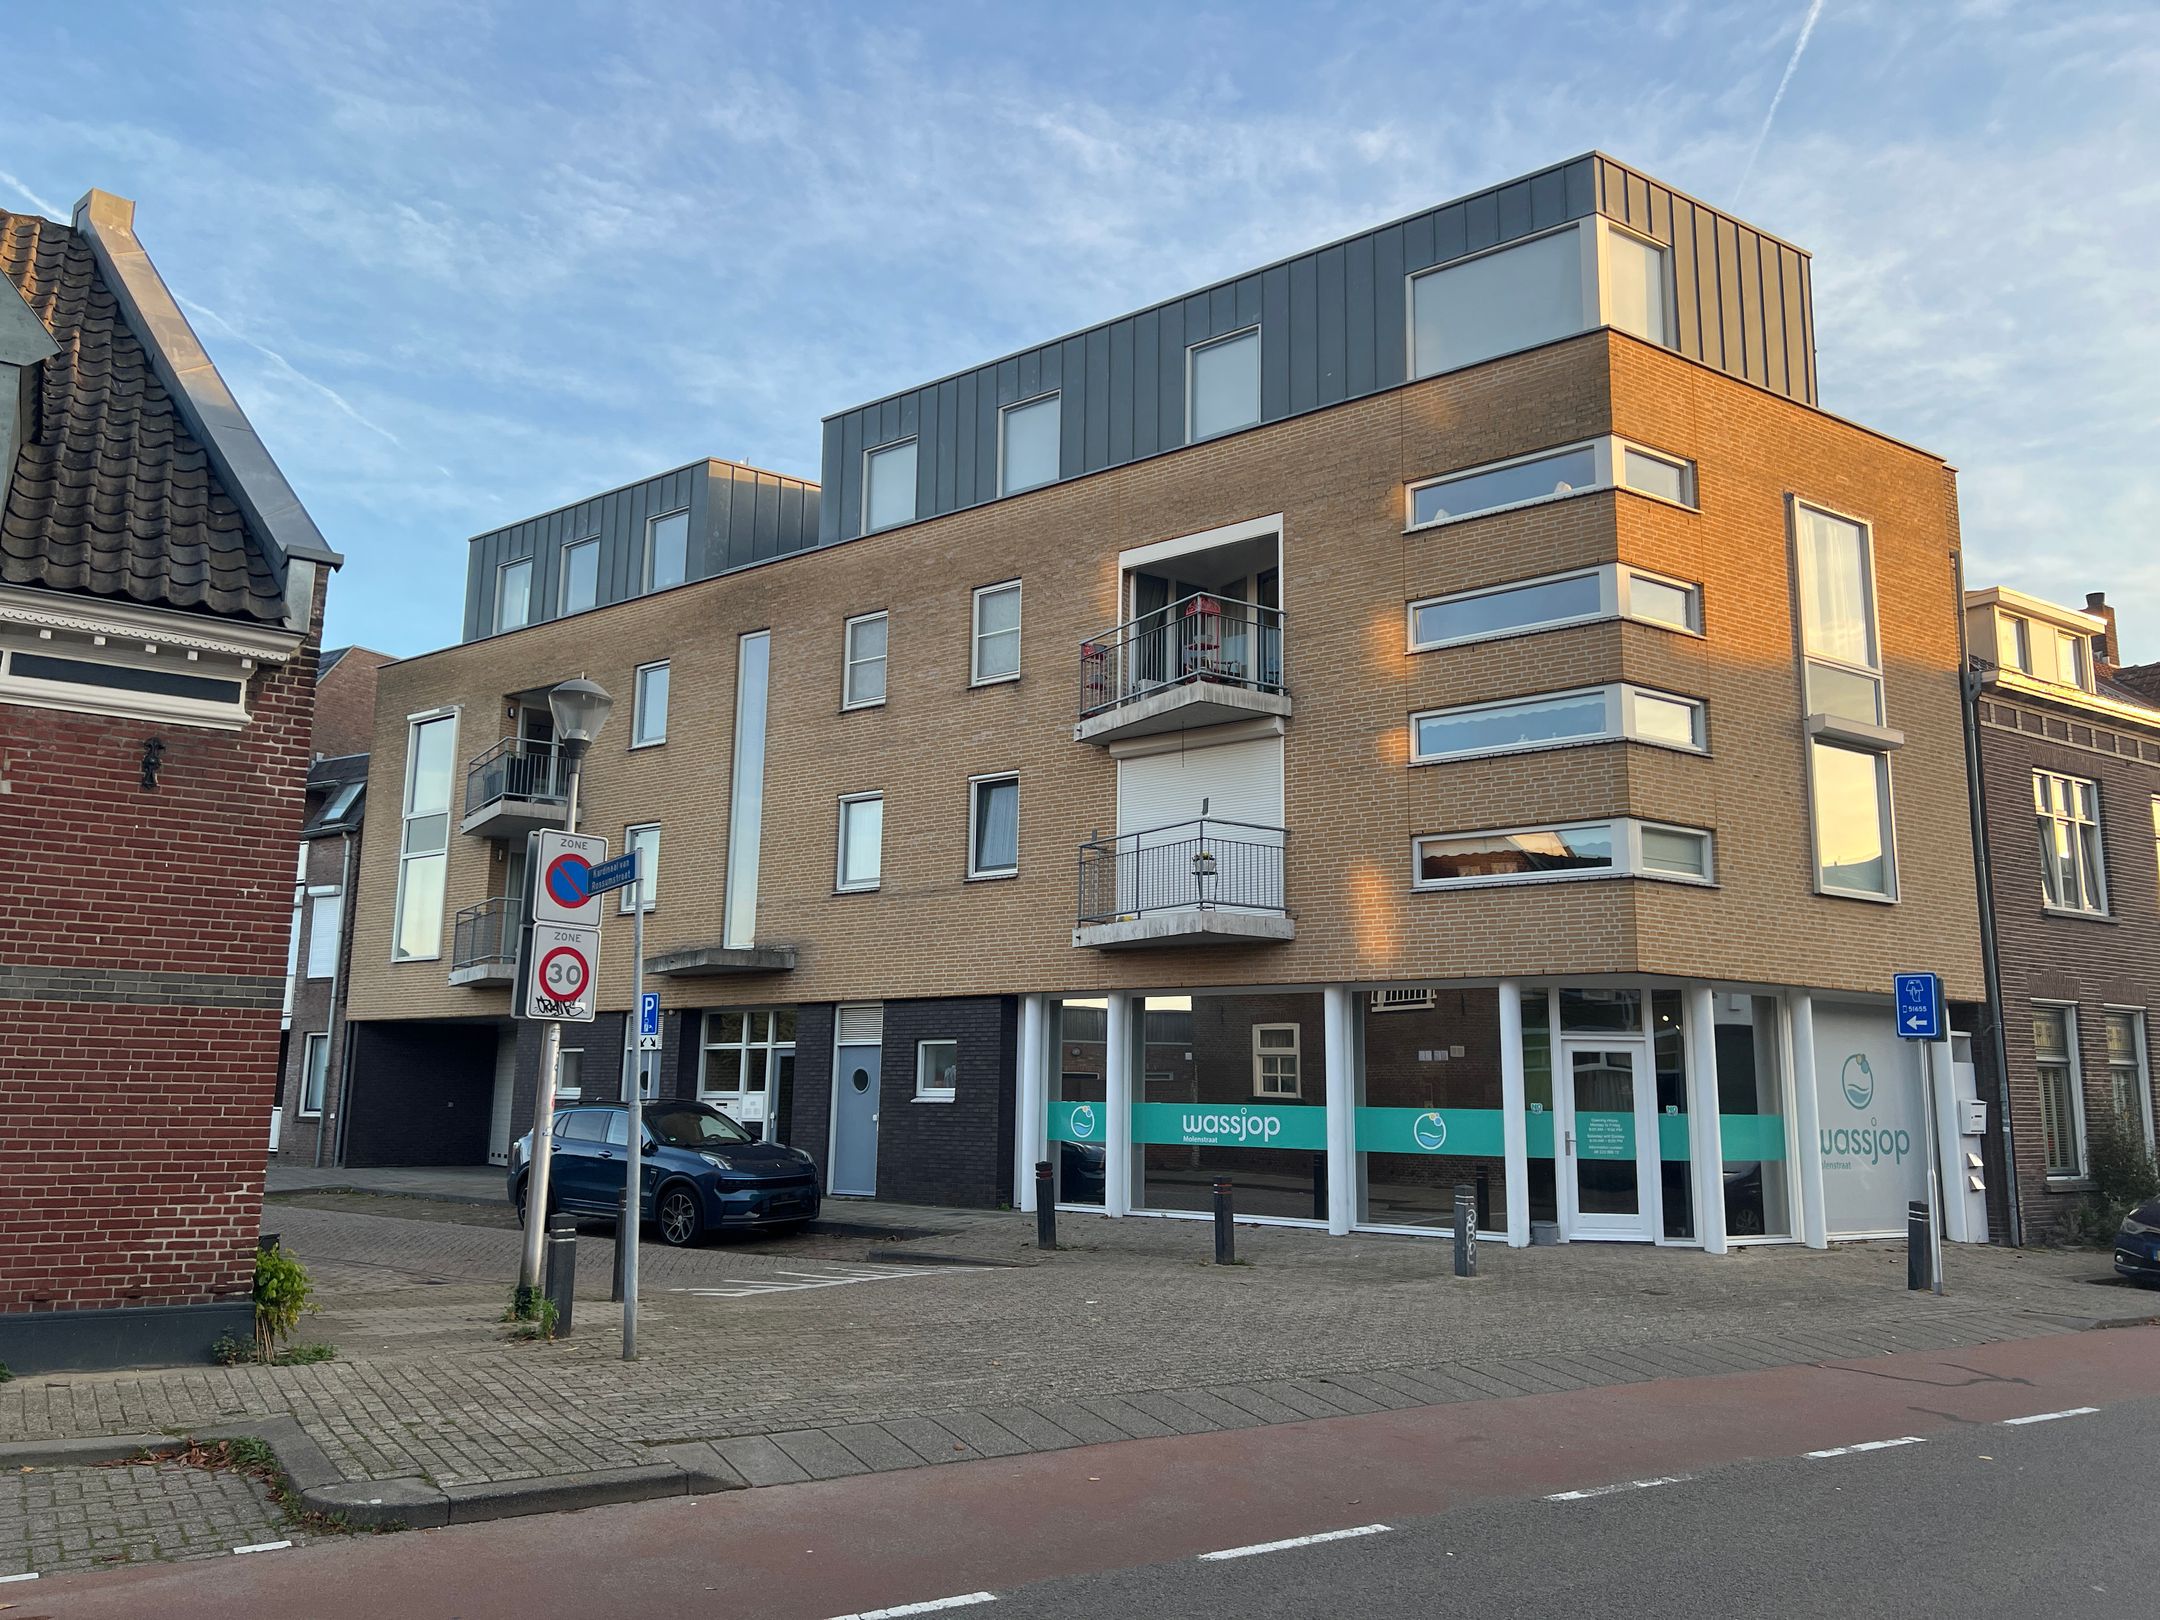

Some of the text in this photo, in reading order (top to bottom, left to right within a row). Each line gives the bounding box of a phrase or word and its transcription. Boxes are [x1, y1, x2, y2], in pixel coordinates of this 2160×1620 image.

[560, 838, 588, 850] ZONE
[554, 931, 582, 943] ZONE
[548, 963, 581, 985] 30
[644, 997, 654, 1018] P
[1183, 1107, 1280, 1142] wassjop
[1183, 1135, 1218, 1143] Molenstraat
